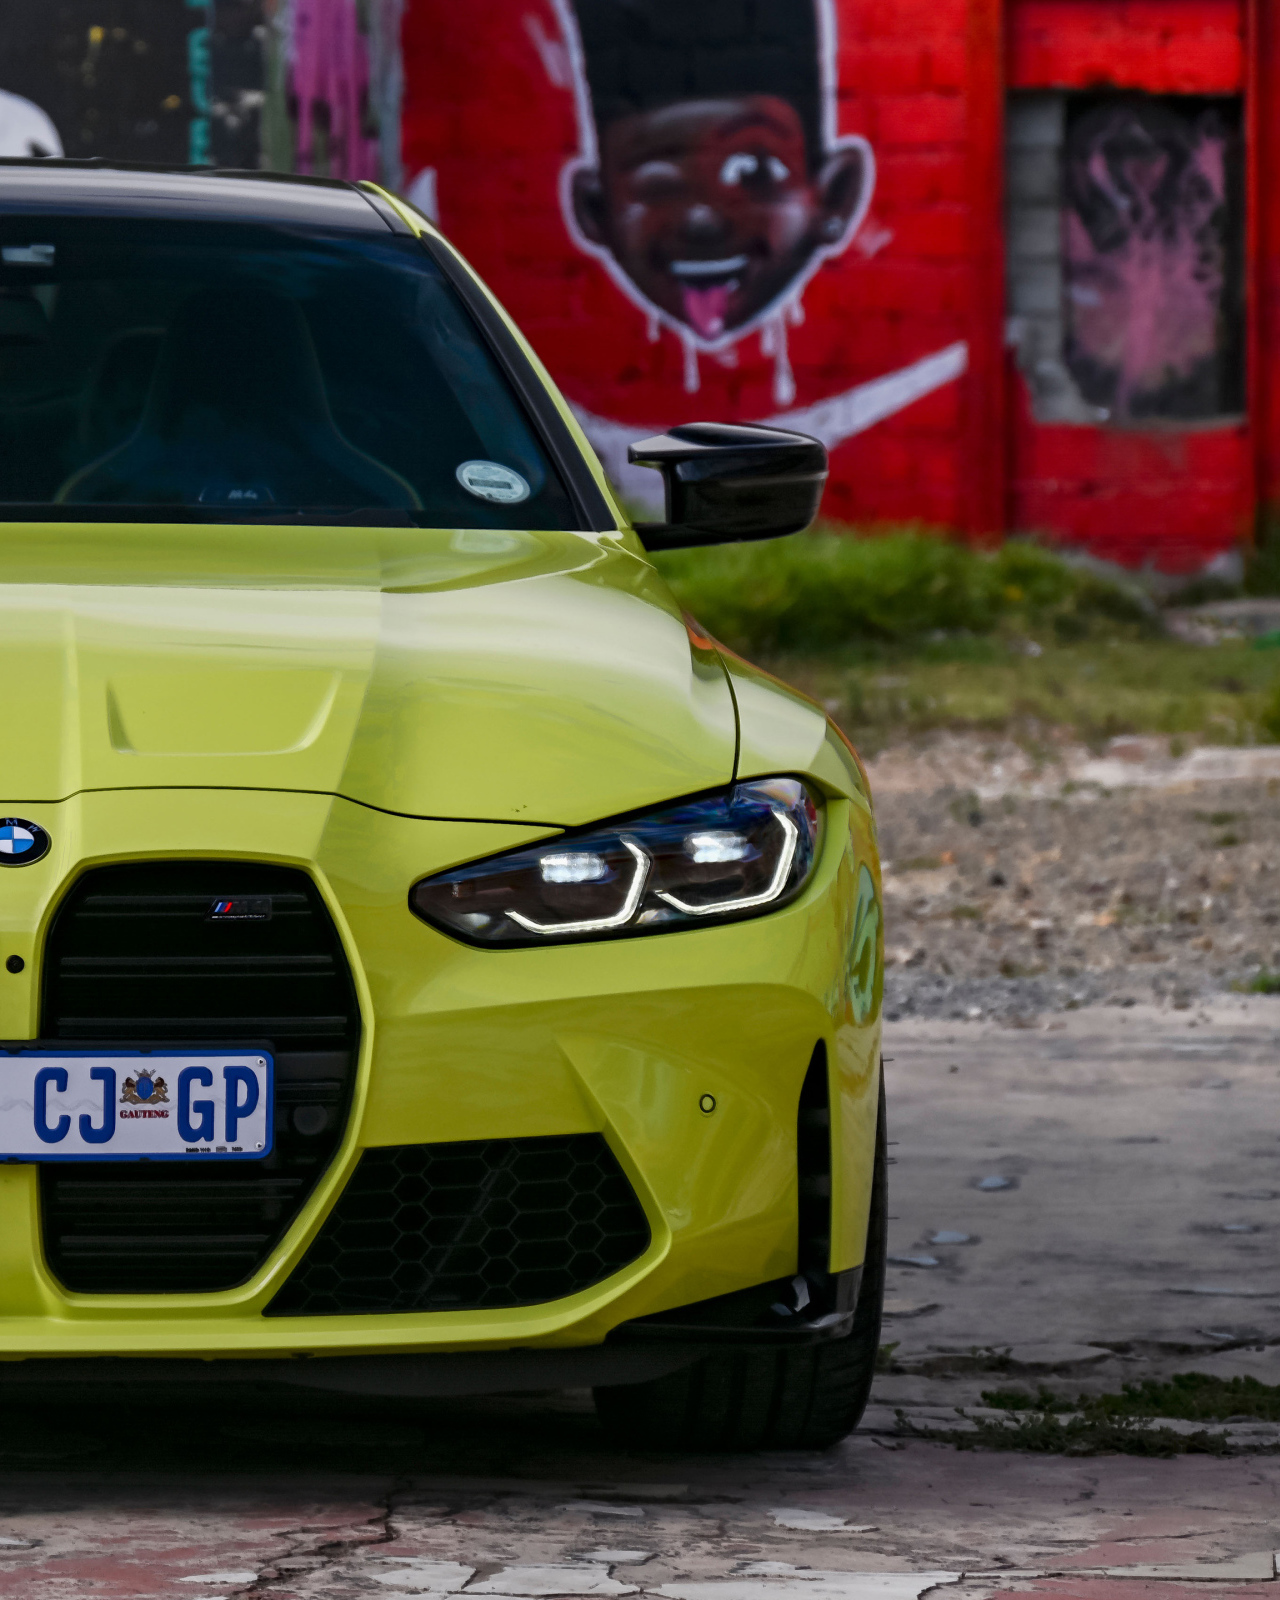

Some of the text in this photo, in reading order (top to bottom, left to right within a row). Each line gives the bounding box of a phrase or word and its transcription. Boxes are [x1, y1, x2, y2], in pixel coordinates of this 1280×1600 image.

[34, 1067, 116, 1144] CJ
[178, 1065, 259, 1143] GP
[120, 1109, 169, 1119] GAUTENG
